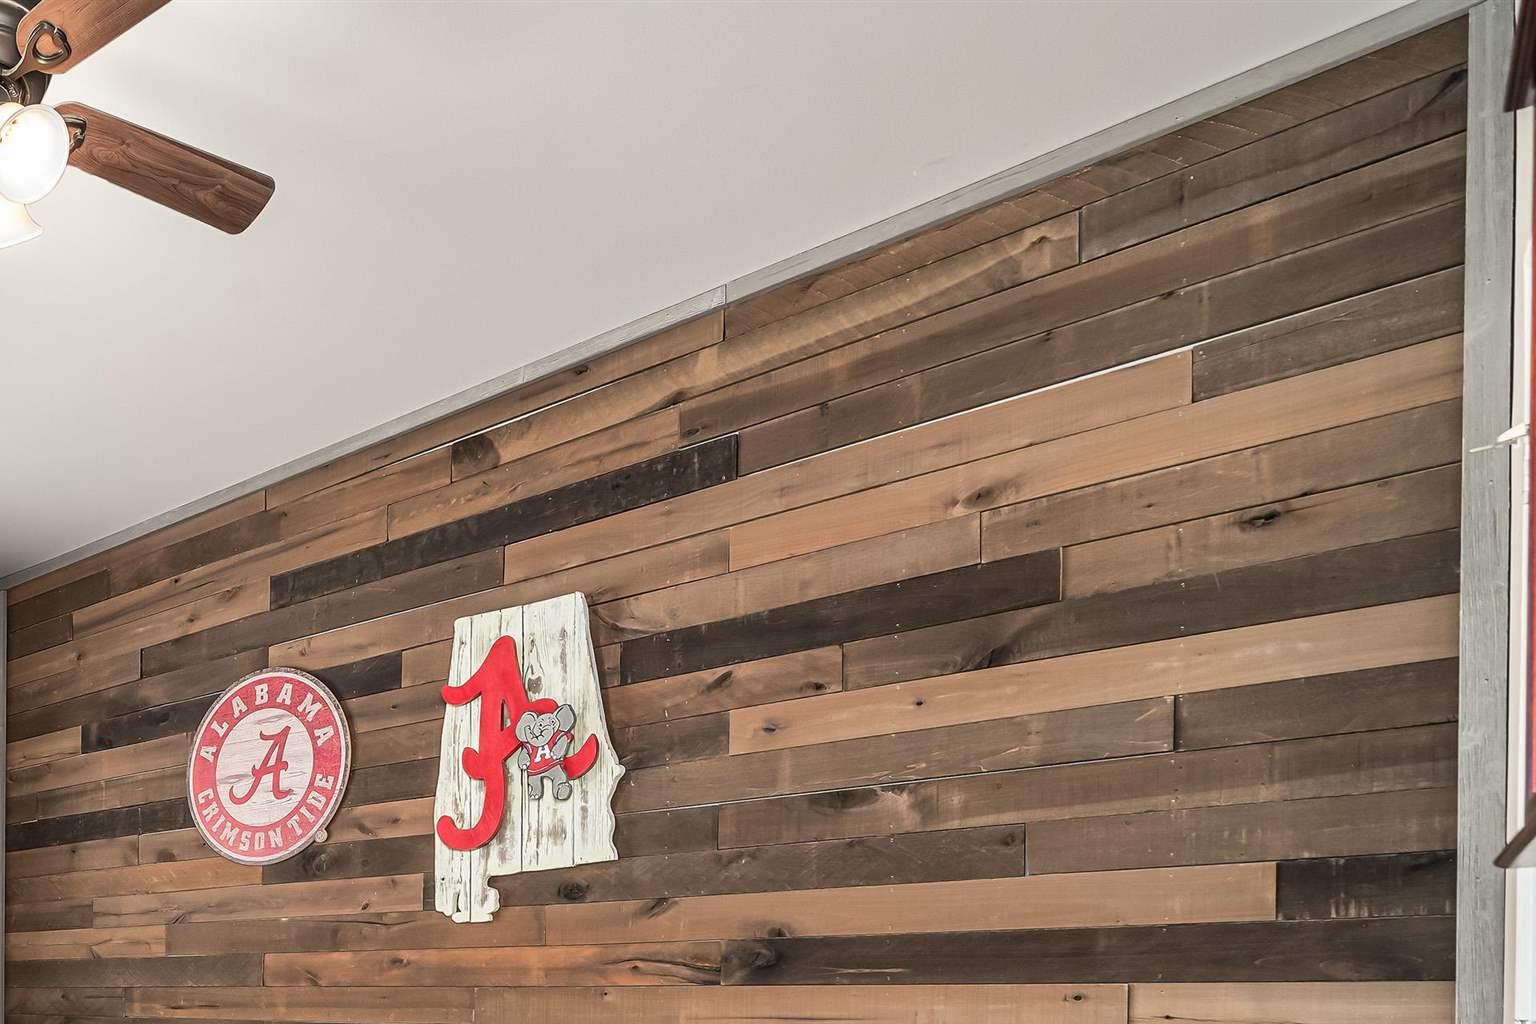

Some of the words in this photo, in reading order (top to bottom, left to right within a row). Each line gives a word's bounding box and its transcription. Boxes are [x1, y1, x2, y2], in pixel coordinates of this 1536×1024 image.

[200, 682, 335, 764] ALABAMA
[534, 745, 552, 763] A
[229, 726, 293, 805] A
[198, 787, 284, 852] CRIMSON
[287, 774, 334, 837] TIDE
